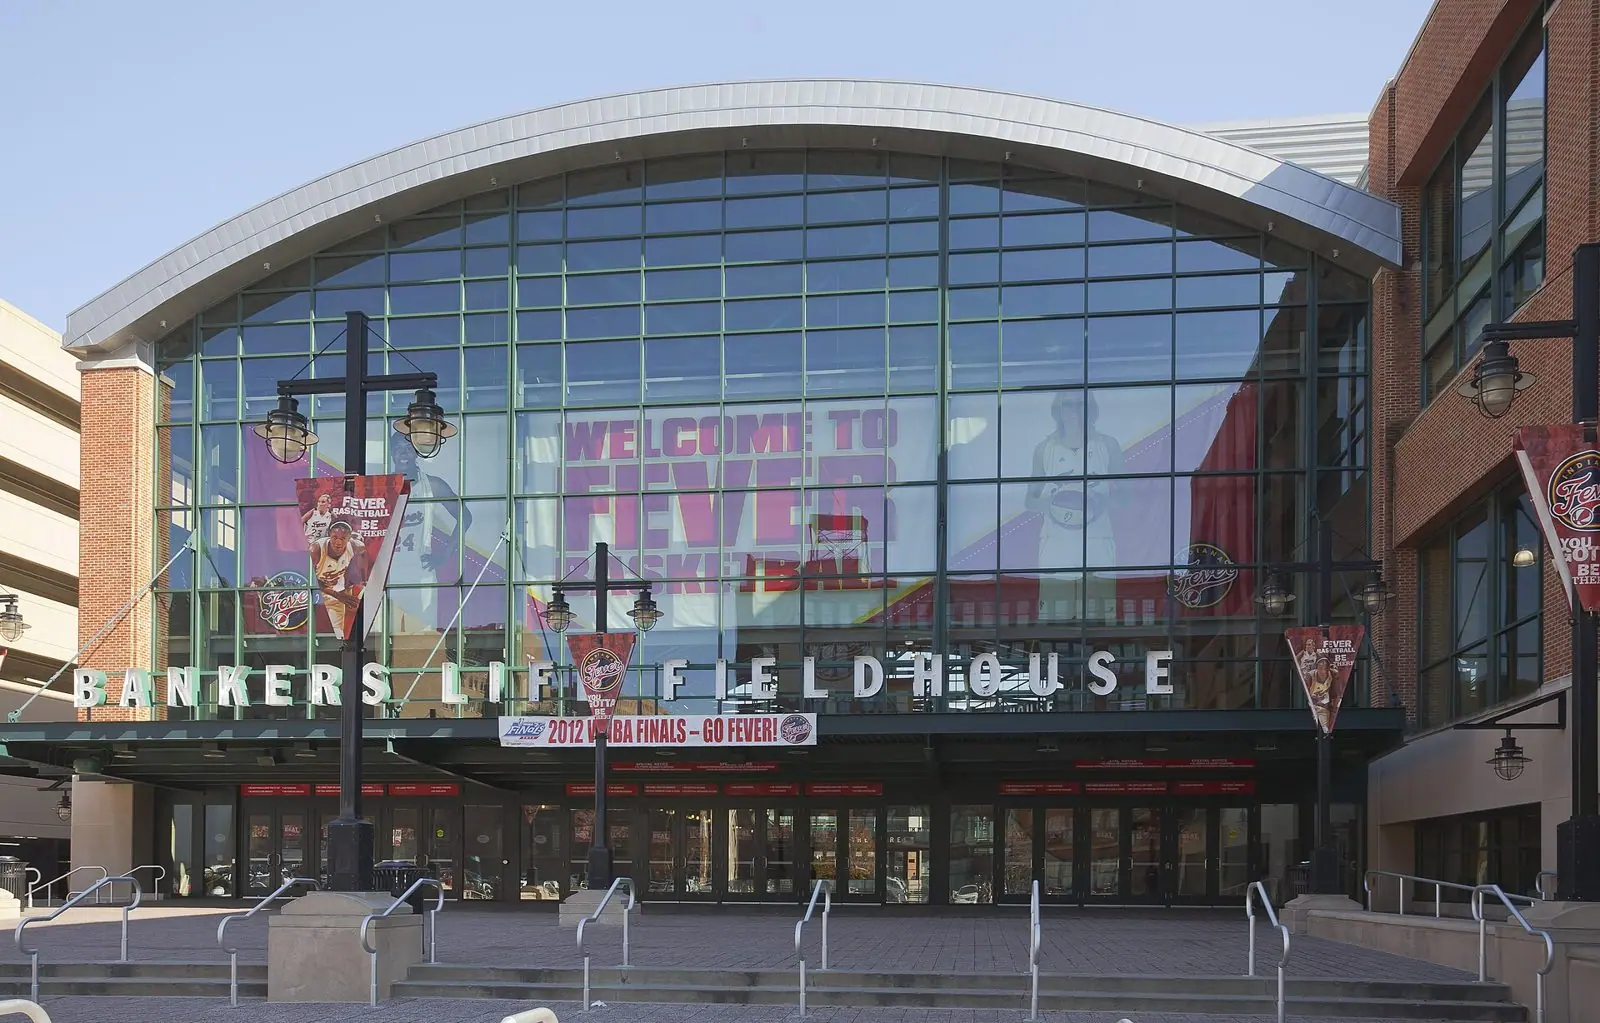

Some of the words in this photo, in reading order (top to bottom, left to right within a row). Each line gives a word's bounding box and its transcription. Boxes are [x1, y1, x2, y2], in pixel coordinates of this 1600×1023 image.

[558, 411, 812, 460] WELCOME
[828, 408, 898, 449] TO
[342, 496, 386, 510] FEVER
[556, 455, 897, 552] FEVER
[332, 507, 390, 517] BASKETBALL
[361, 520, 378, 530] BE
[1560, 537, 1592, 548] YOU
[553, 548, 897, 597] BASKETBALL
[1577, 564, 1600, 577] BE
[1323, 640, 1352, 648] FEVER
[73, 662, 392, 708] BANKERS
[442, 661, 588, 704] LIF
[663, 650, 1175, 701] FIELDHOUSE
[587, 694, 601, 702] YOU
[594, 708, 605, 716] BE
[548, 719, 584, 744] 2012
[636, 718, 686, 744] FINALS
[703, 717, 724, 742] GO
[728, 717, 777, 742] FEVER!
